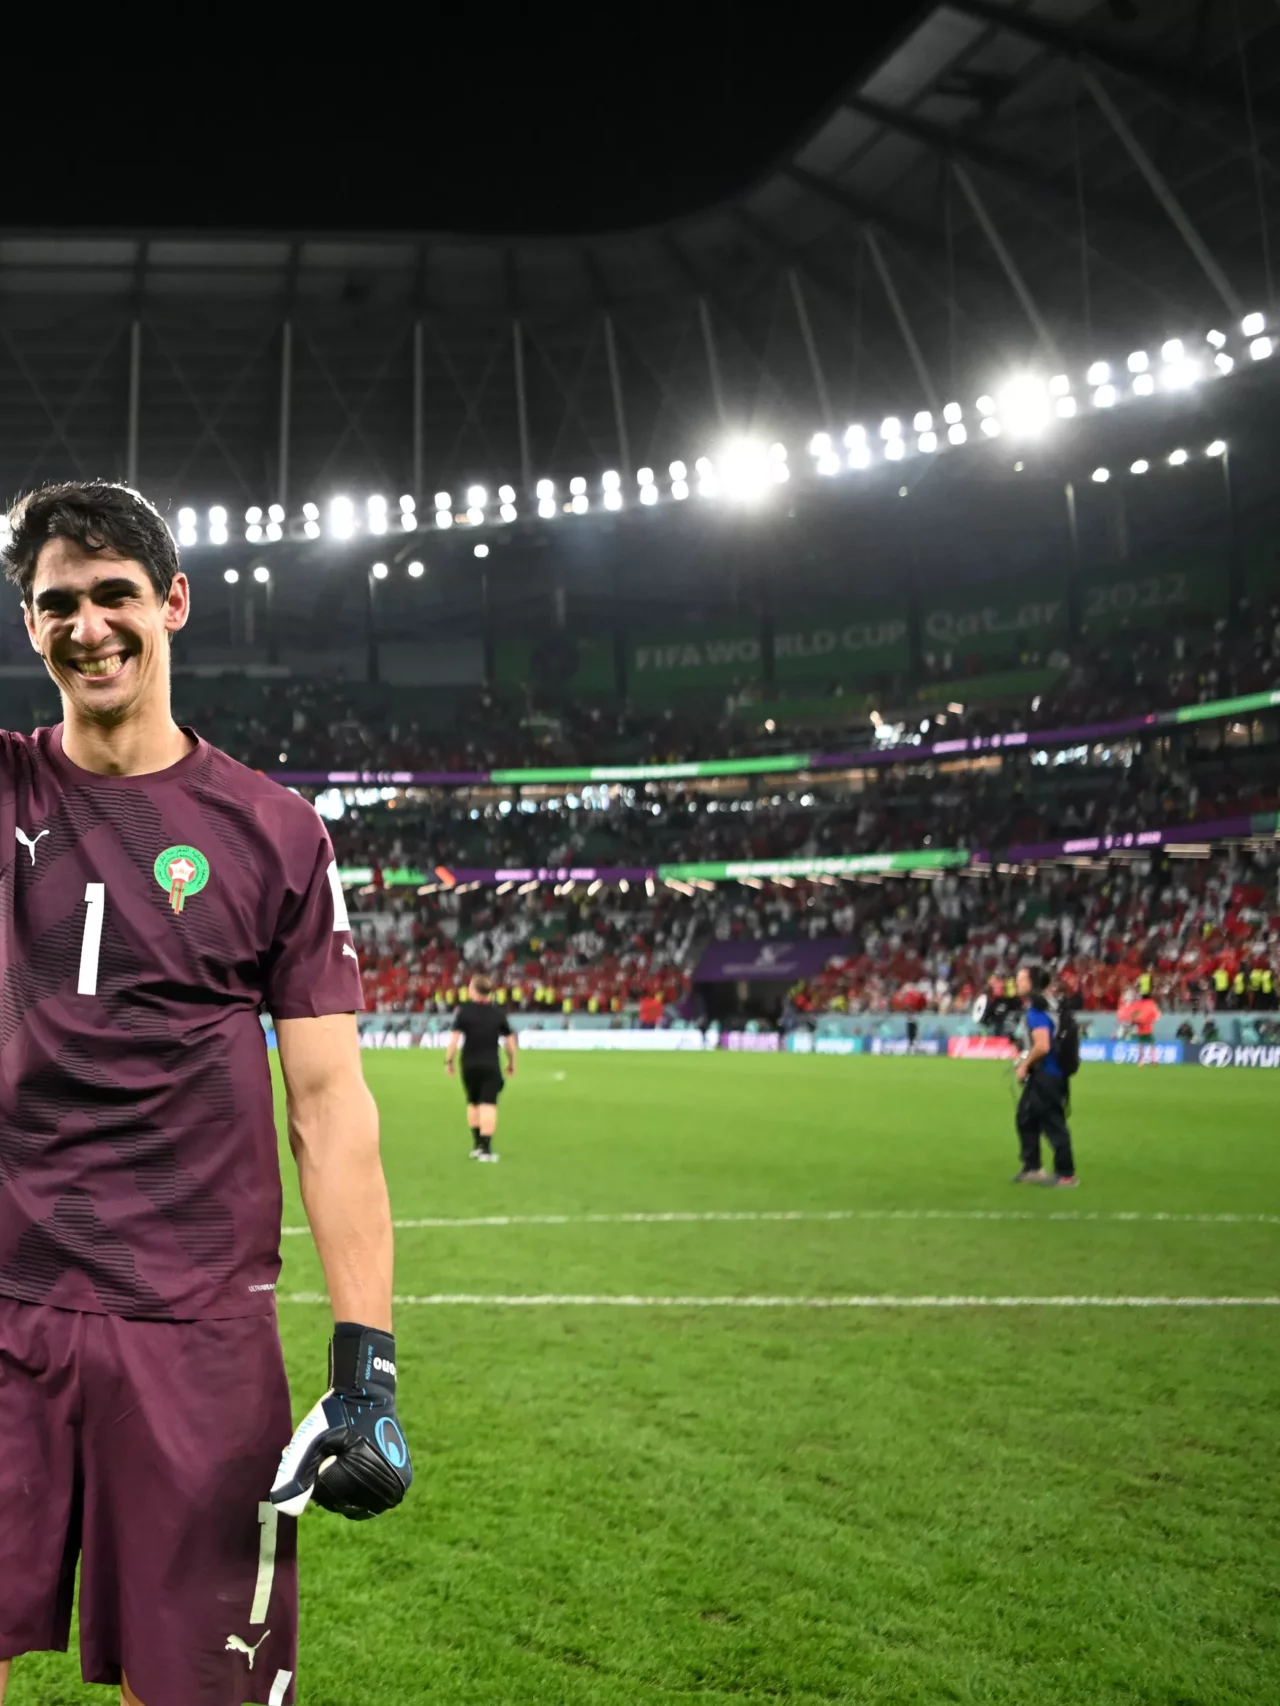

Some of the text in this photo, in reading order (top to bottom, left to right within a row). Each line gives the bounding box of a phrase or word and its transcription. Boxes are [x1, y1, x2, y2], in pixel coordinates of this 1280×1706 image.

[634, 644, 705, 671] FIFA
[705, 629, 836, 664] WORLD
[842, 619, 909, 650] CUP
[1086, 573, 1188, 618] 2022
[78, 883, 105, 995] 1
[358, 1030, 412, 1050] ATAR
[249, 1501, 278, 1624] 1
